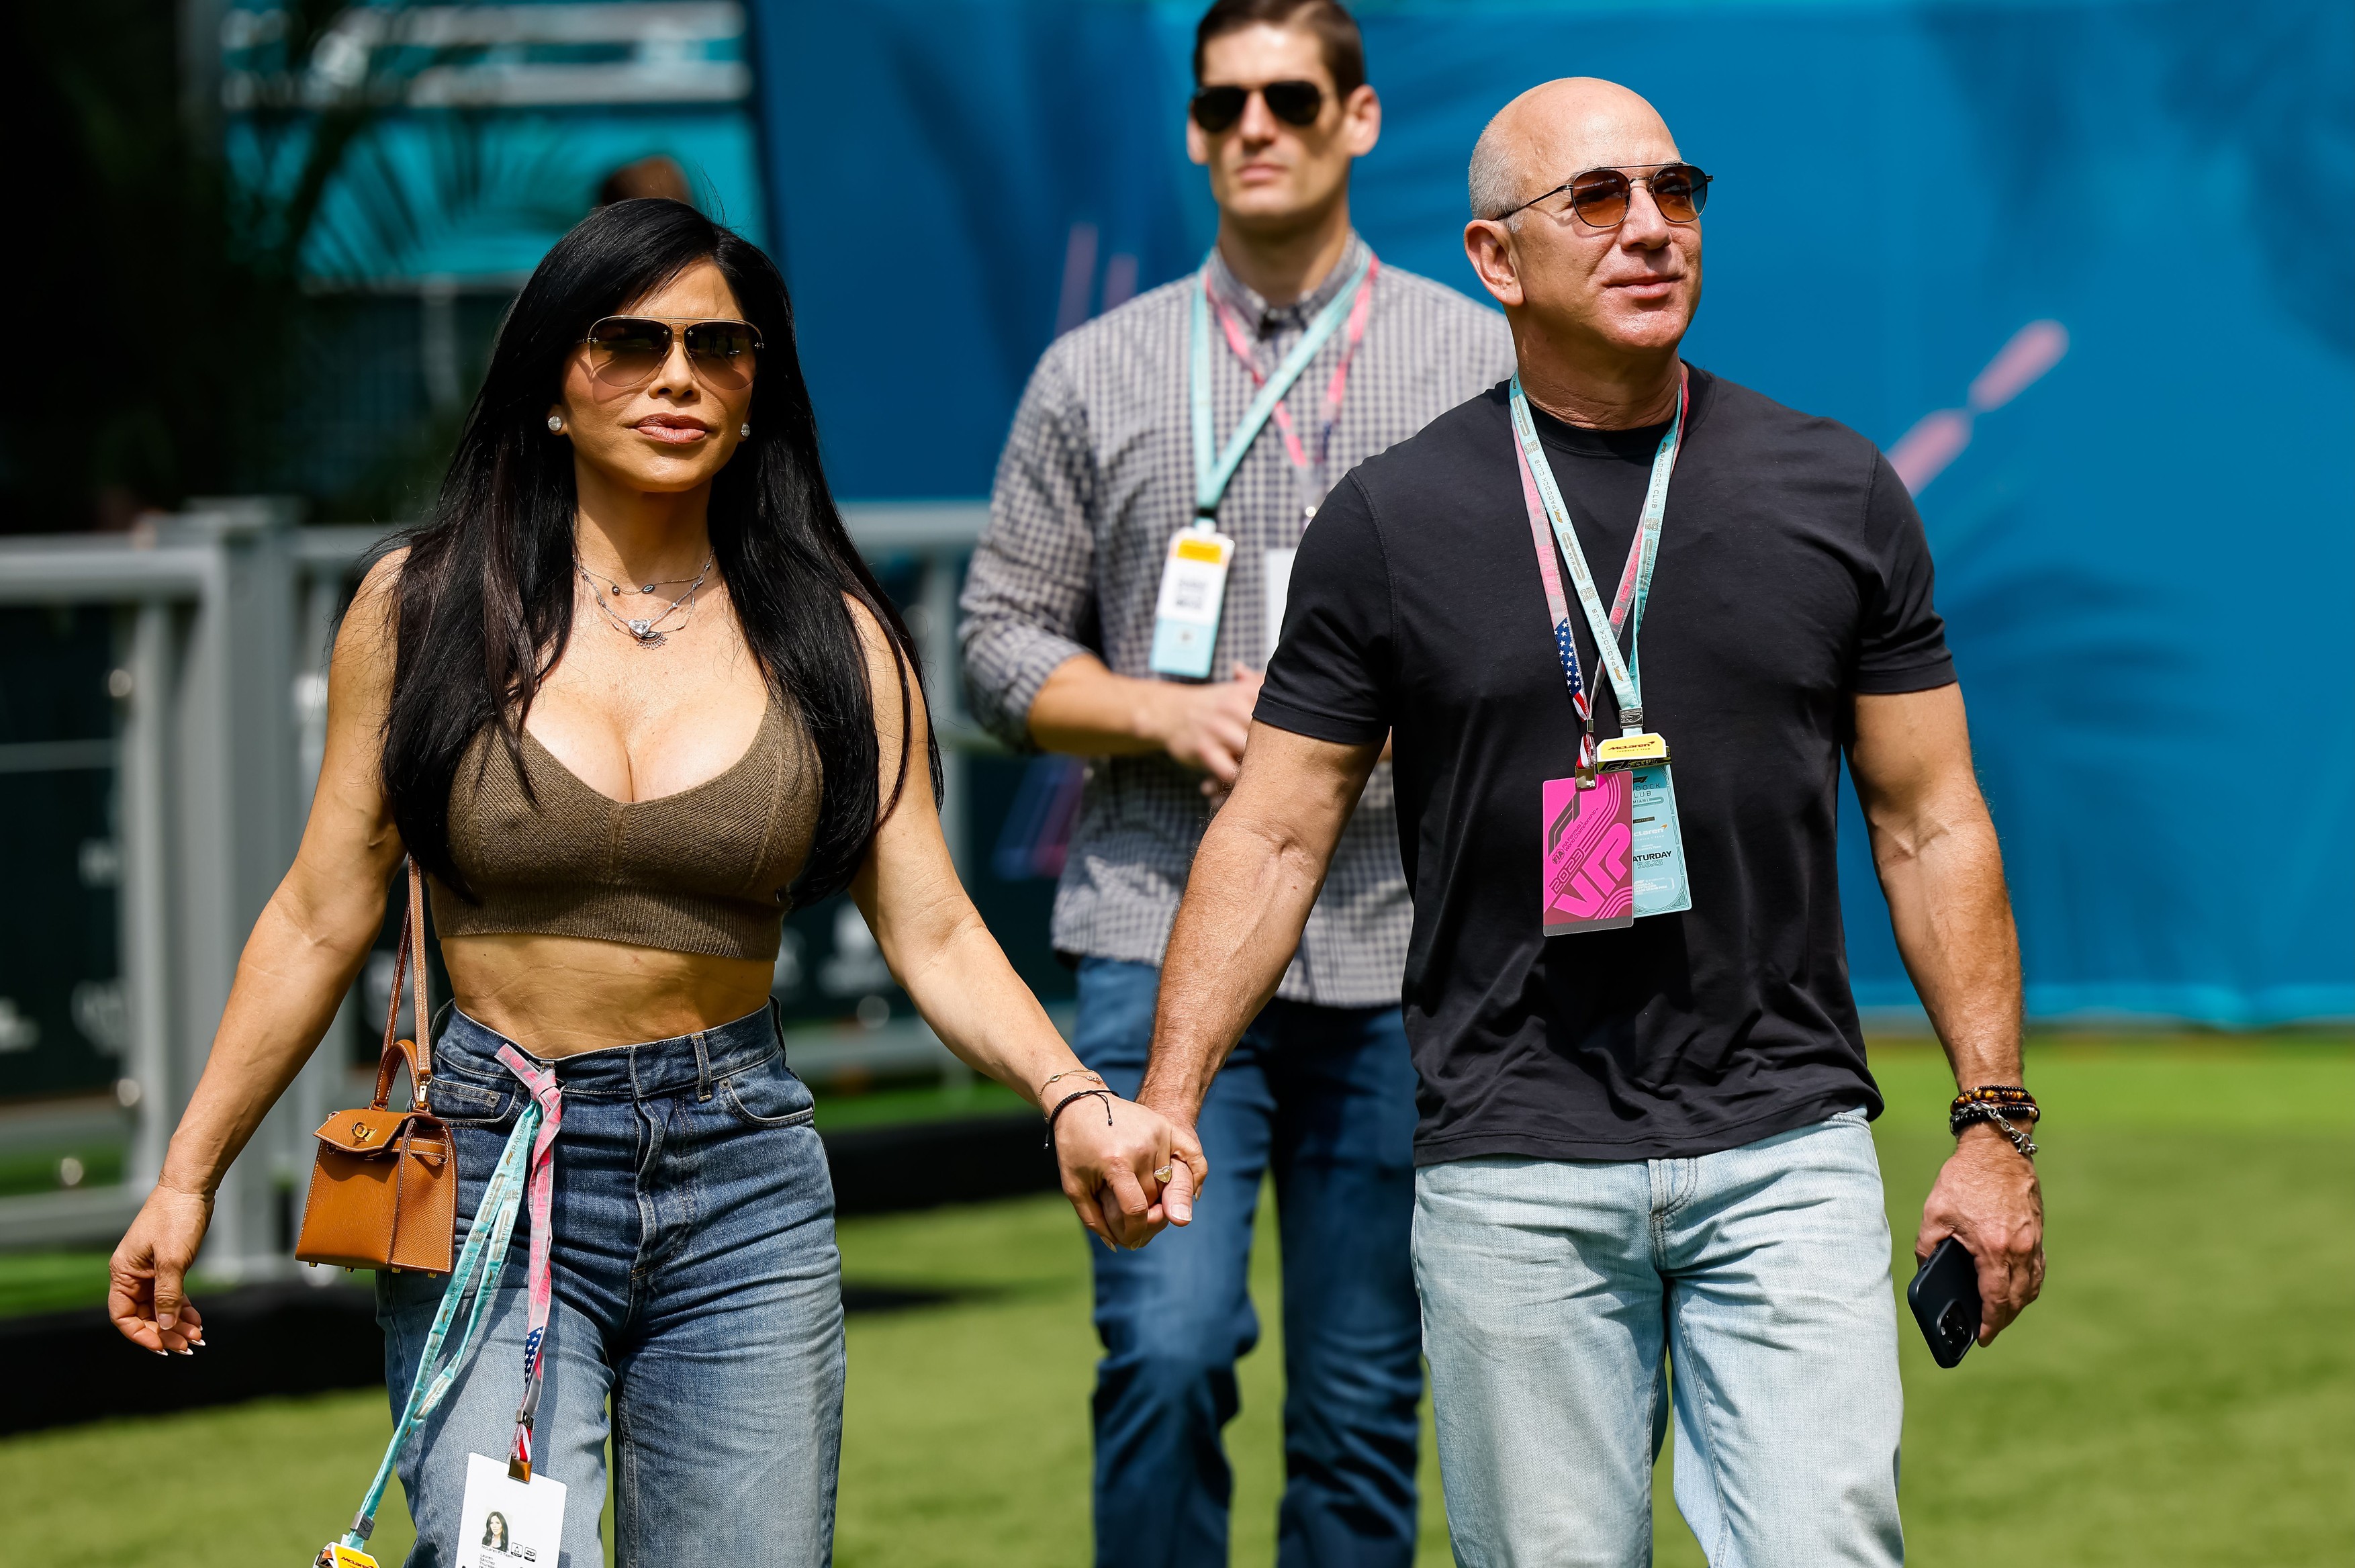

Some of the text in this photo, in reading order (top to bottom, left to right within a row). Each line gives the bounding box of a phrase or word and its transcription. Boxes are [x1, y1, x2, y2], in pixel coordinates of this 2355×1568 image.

[1534, 459, 1545, 476] CLUB
[1655, 455, 1665, 487] PADDOCK
[1542, 477, 1558, 510] PADDOCK
[1567, 549, 1575, 565] MIAMI
[1592, 608, 1602, 628] CLUB
[1600, 630, 1616, 665] PADDOCK
[1608, 741, 1655, 750] McLaren
[1633, 783, 1661, 792] DOCK
[1634, 826, 1666, 836] cLaren
[1633, 851, 1672, 862] ATURDAY
[1637, 859, 1663, 869] 5.6.23
[1549, 848, 1584, 894] 2023
[512, 1117, 528, 1152] PADDOC
[486, 1190, 495, 1205] MIAMI
[447, 1273, 464, 1308] PADDOCK
[462, 1251, 473, 1271] CLUB
